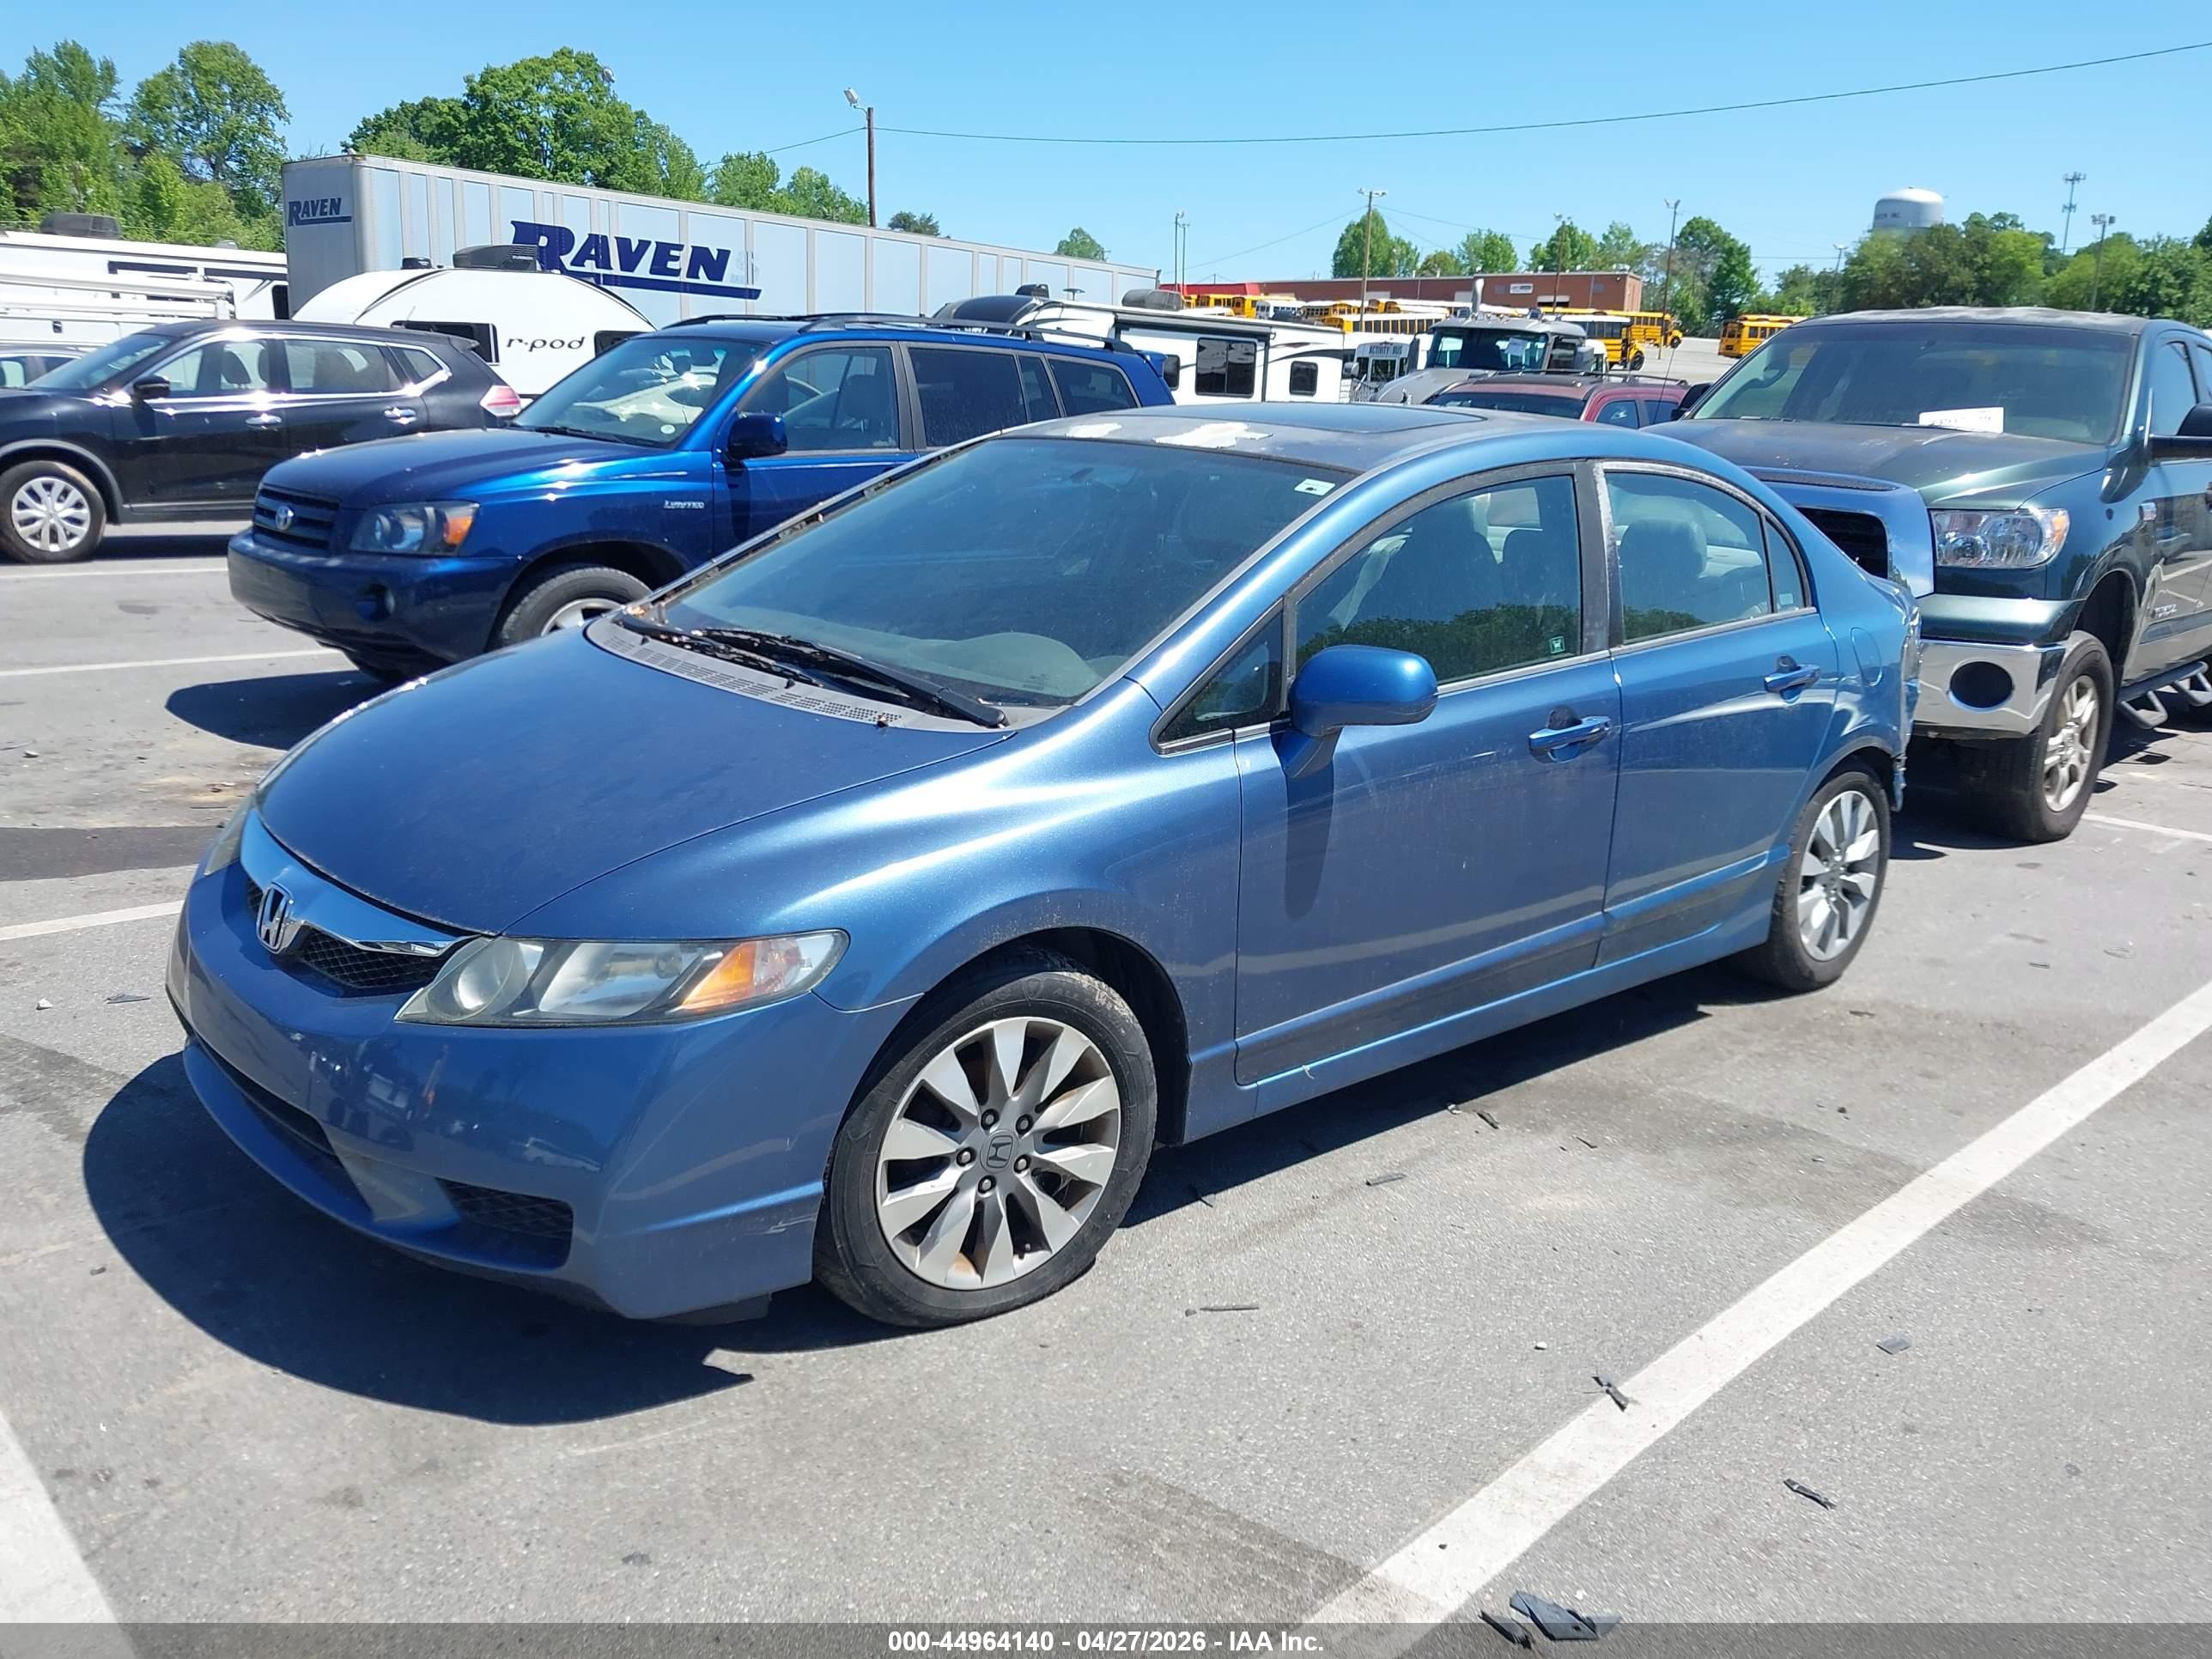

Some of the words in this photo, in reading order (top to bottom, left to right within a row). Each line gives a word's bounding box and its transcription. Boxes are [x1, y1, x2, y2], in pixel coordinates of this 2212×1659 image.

[288, 198, 342, 227] RAVEN
[510, 220, 732, 282] RAVEN
[1369, 345, 1389, 355] ACTIVITY
[1393, 345, 1402, 355] BUS
